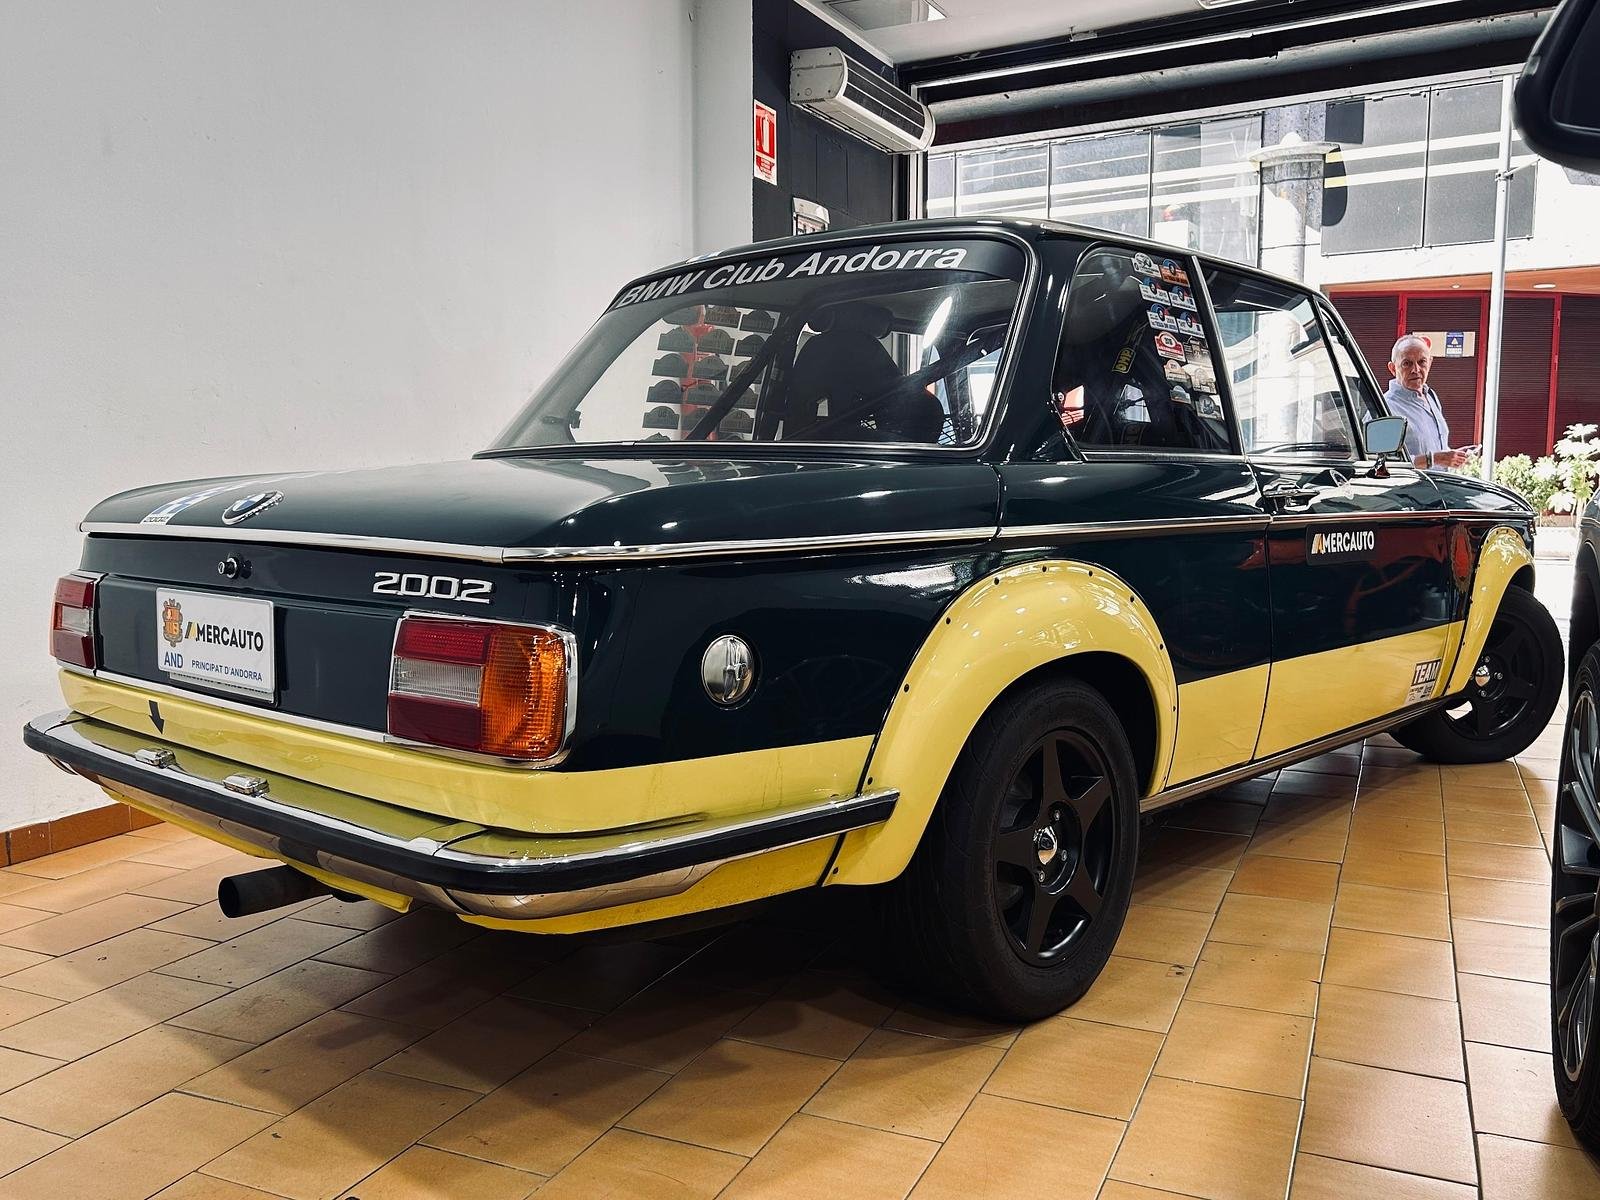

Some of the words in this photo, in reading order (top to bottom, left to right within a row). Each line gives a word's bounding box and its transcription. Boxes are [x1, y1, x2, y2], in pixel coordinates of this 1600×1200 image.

[615, 270, 707, 308] BMW
[703, 257, 785, 290] Club
[788, 245, 967, 278] Andorra
[1115, 349, 1132, 371] OMP
[1321, 530, 1375, 555] MERCAUTO
[372, 571, 493, 604] 2002
[195, 622, 264, 652] MERCAUTO
[163, 651, 184, 669] AND
[191, 659, 223, 674] PRINCIPAT
[224, 664, 263, 682] D'ANDORRA
[1413, 660, 1441, 685] TEAM
